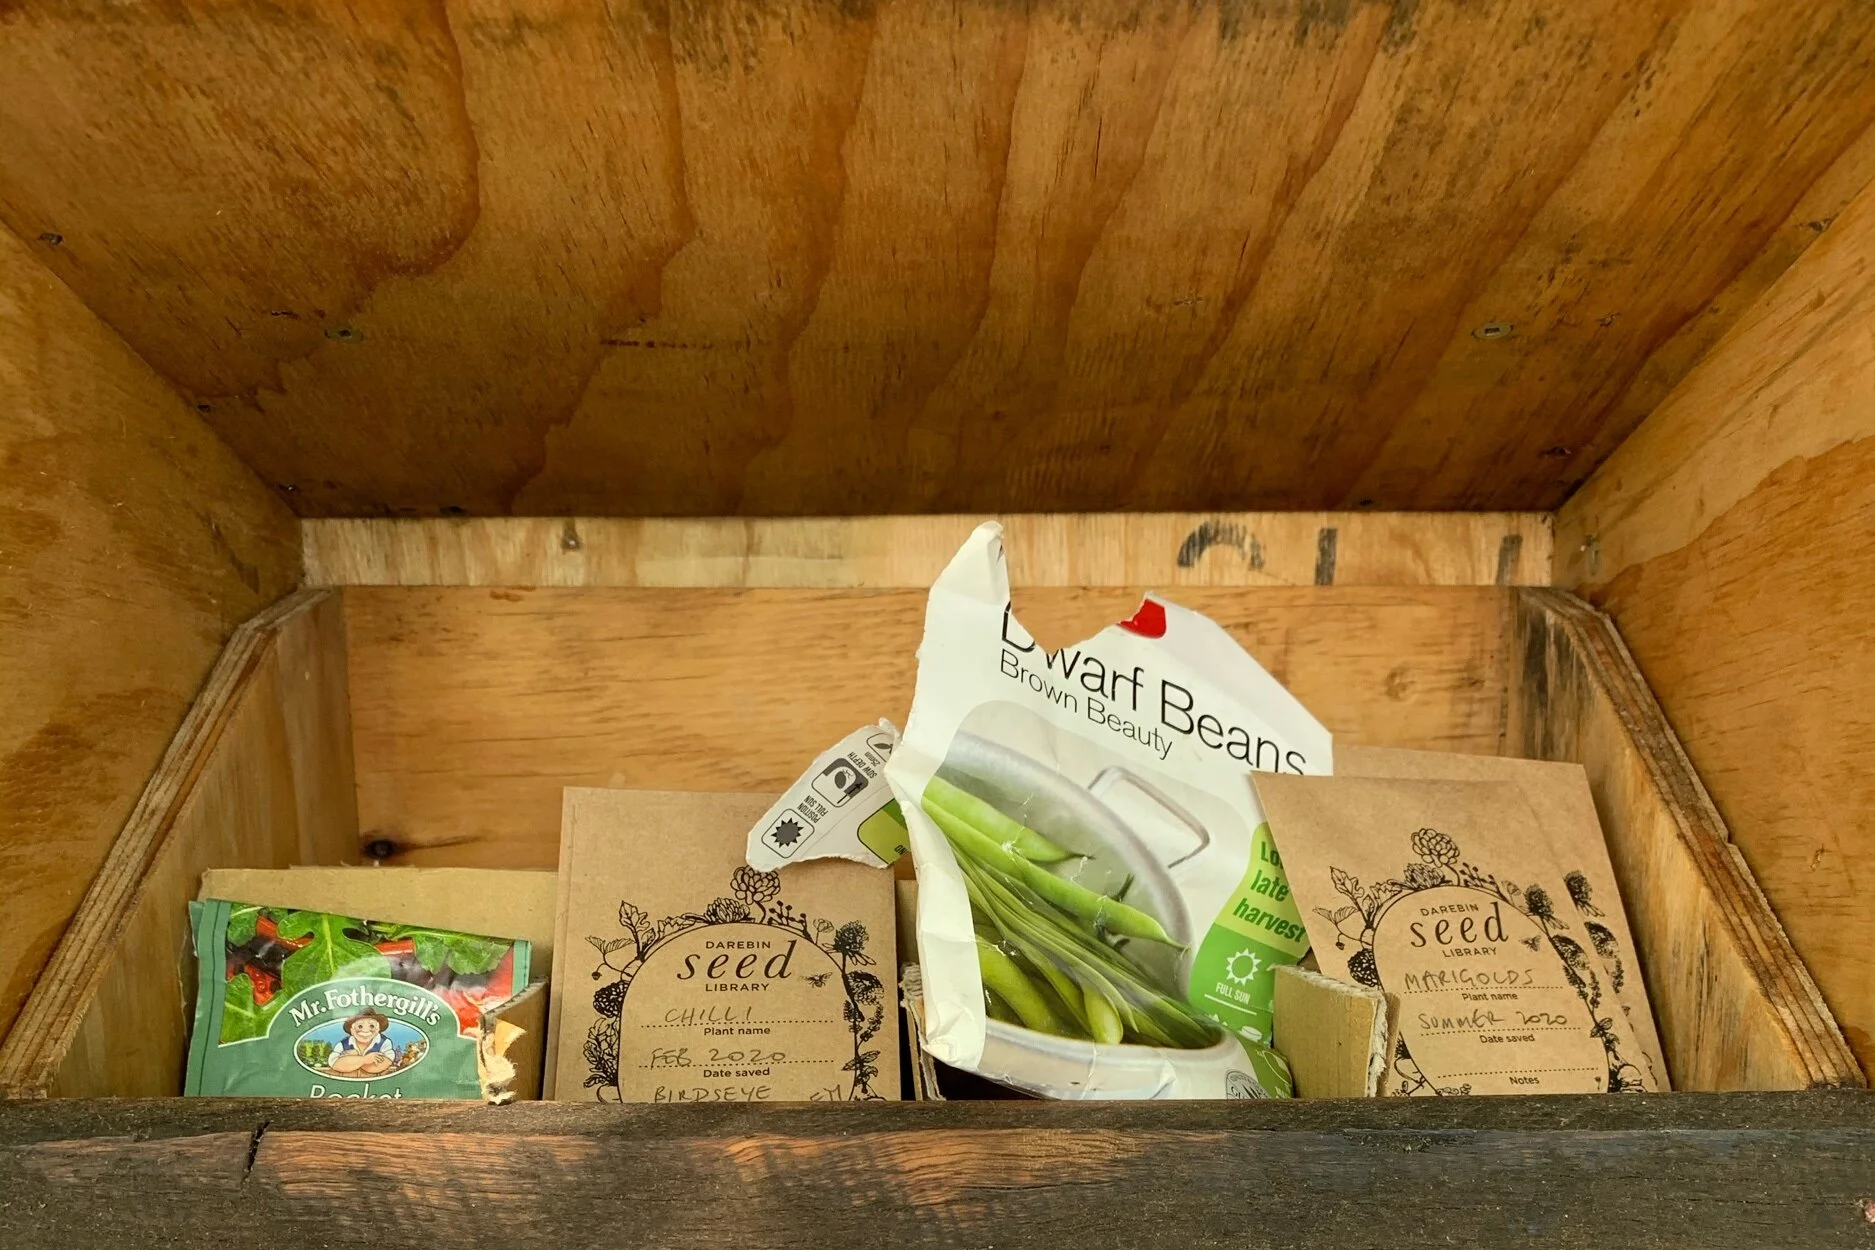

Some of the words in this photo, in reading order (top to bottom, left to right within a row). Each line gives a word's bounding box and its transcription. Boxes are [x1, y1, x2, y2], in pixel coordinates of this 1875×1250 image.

[1000, 648, 1078, 713] Brown
[1086, 696, 1174, 761] Beauty
[1160, 678, 1307, 775] Beans
[847, 751, 867, 768] DEPTH
[797, 802, 821, 824] POSITION
[1260, 841, 1284, 870] Lo
[1250, 869, 1290, 902] late
[1232, 897, 1307, 943] harvest
[1420, 903, 1480, 917] DAREBIN
[1410, 901, 1509, 948] seed
[705, 940, 772, 950] DAREBIN
[1442, 946, 1497, 958] LIBRARY
[677, 939, 796, 980] seed
[705, 983, 771, 993] LIBRARY
[1404, 968, 1535, 991] MARIGOLDS
[1215, 982, 1233, 999] FULL
[1234, 989, 1251, 1005] SUN
[1461, 992, 1489, 1001] Plant
[289, 1000, 326, 1028] Mr.
[324, 985, 443, 1026] Fothergill's
[664, 1005, 753, 1025] CHILLI
[1516, 1011, 1568, 1026] 2020
[703, 1026, 734, 1036] Plant
[738, 1027, 771, 1036] name
[1479, 1034, 1504, 1044] Date
[1505, 1033, 1536, 1043] saved
[651, 1048, 693, 1071] FEB
[708, 1048, 787, 1063] 2020
[703, 1068, 732, 1078] Date
[735, 1067, 771, 1077] saved
[1509, 1076, 1540, 1085] Notes
[654, 1085, 772, 1102] BIRDSEYE
